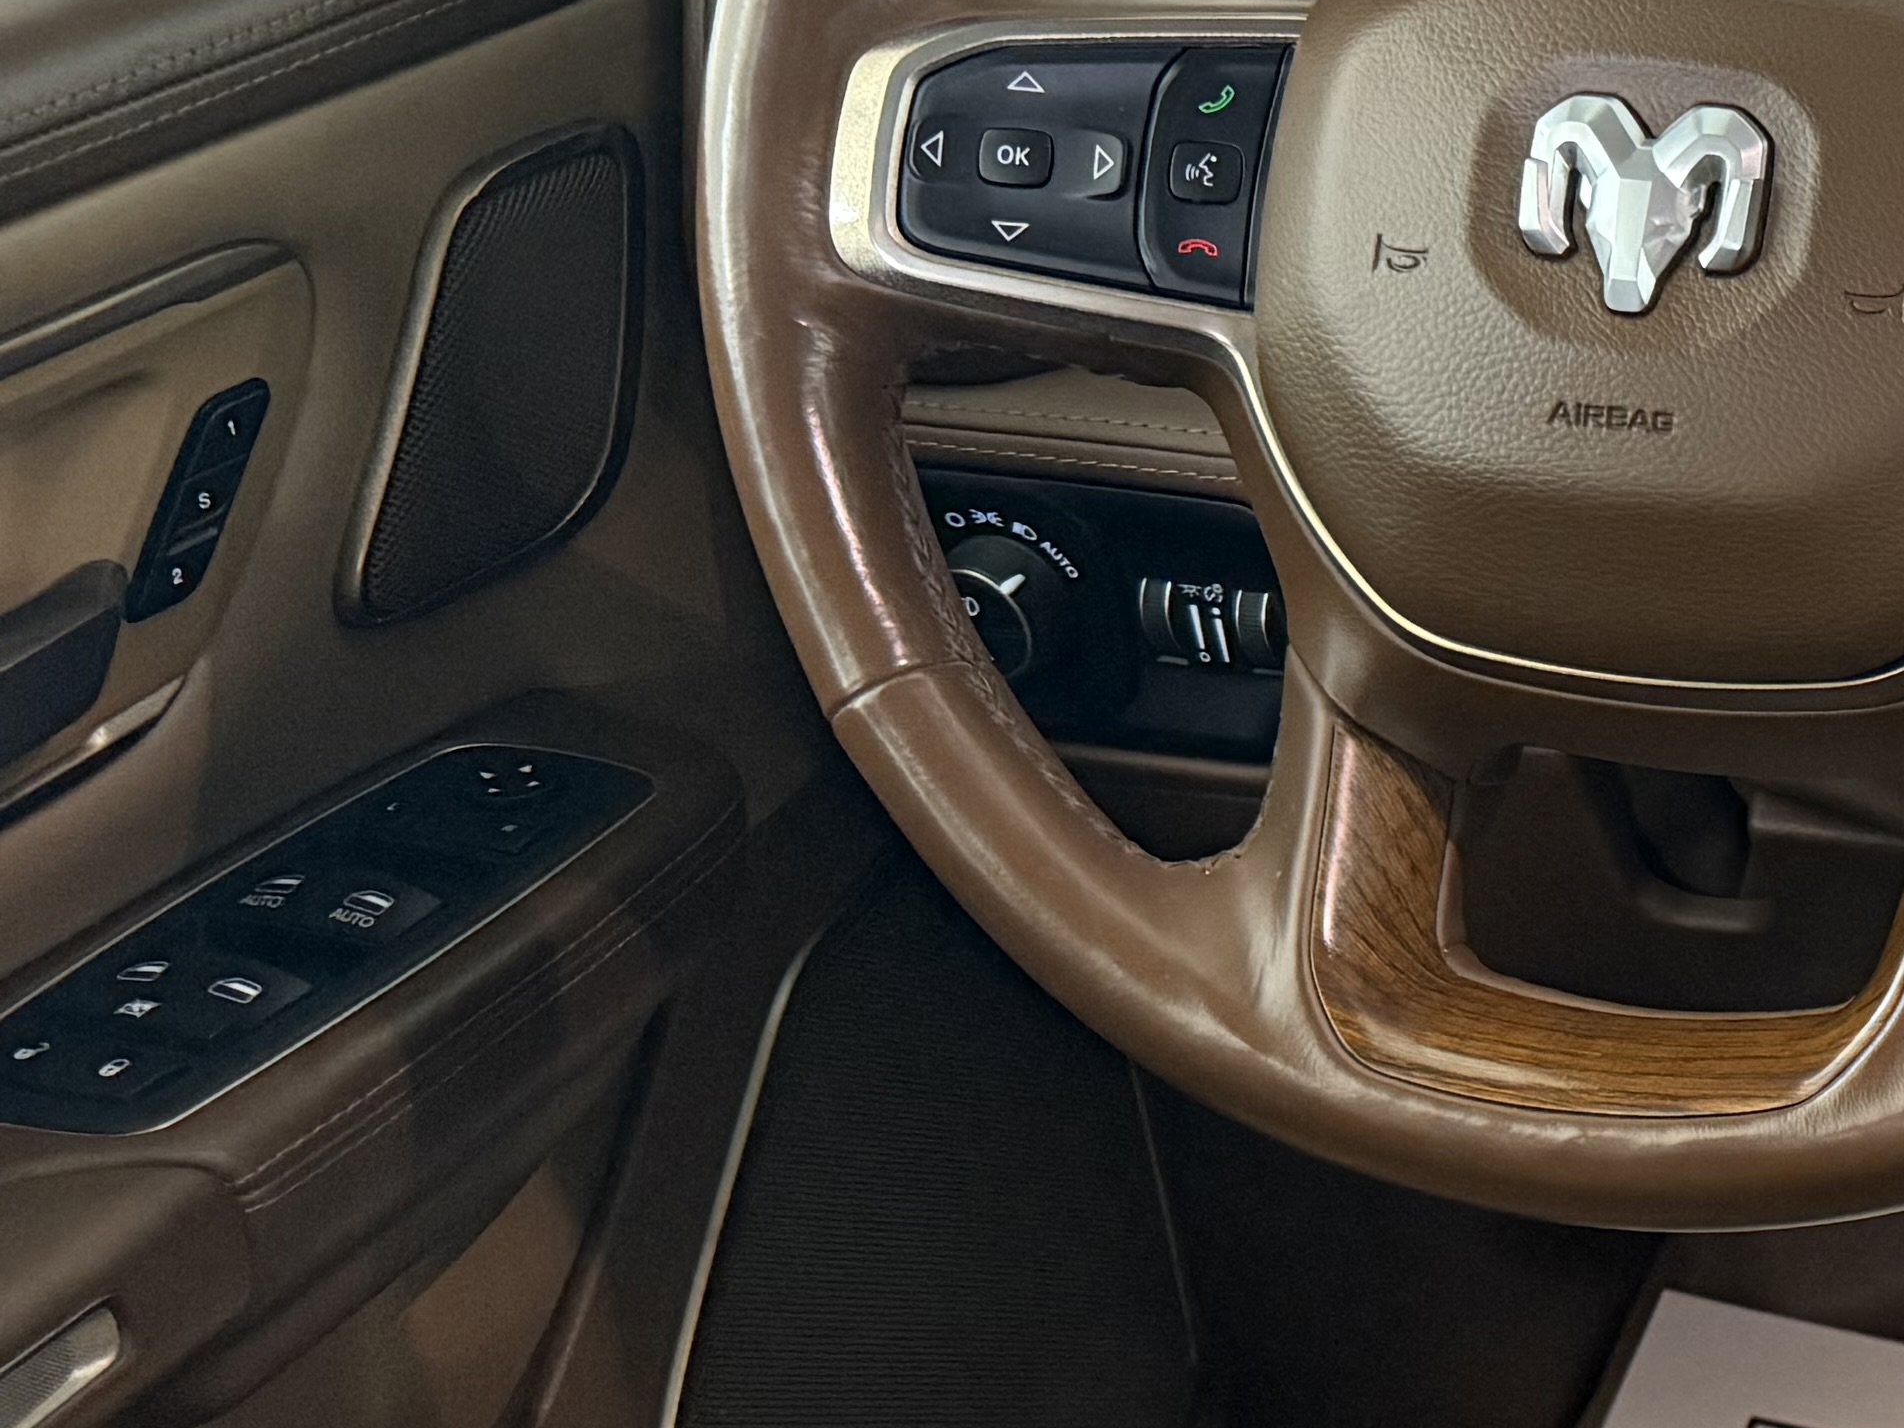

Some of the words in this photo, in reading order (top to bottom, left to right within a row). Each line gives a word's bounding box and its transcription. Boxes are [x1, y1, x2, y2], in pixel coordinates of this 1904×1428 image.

[996, 145, 1031, 167] OK
[1546, 400, 1675, 434] AIRBAG
[226, 419, 237, 436] 1
[198, 492, 211, 510] S
[1040, 541, 1080, 579] AUTO
[171, 567, 184, 585] 2
[238, 894, 286, 909] AUTO
[328, 907, 375, 928] AUTO
